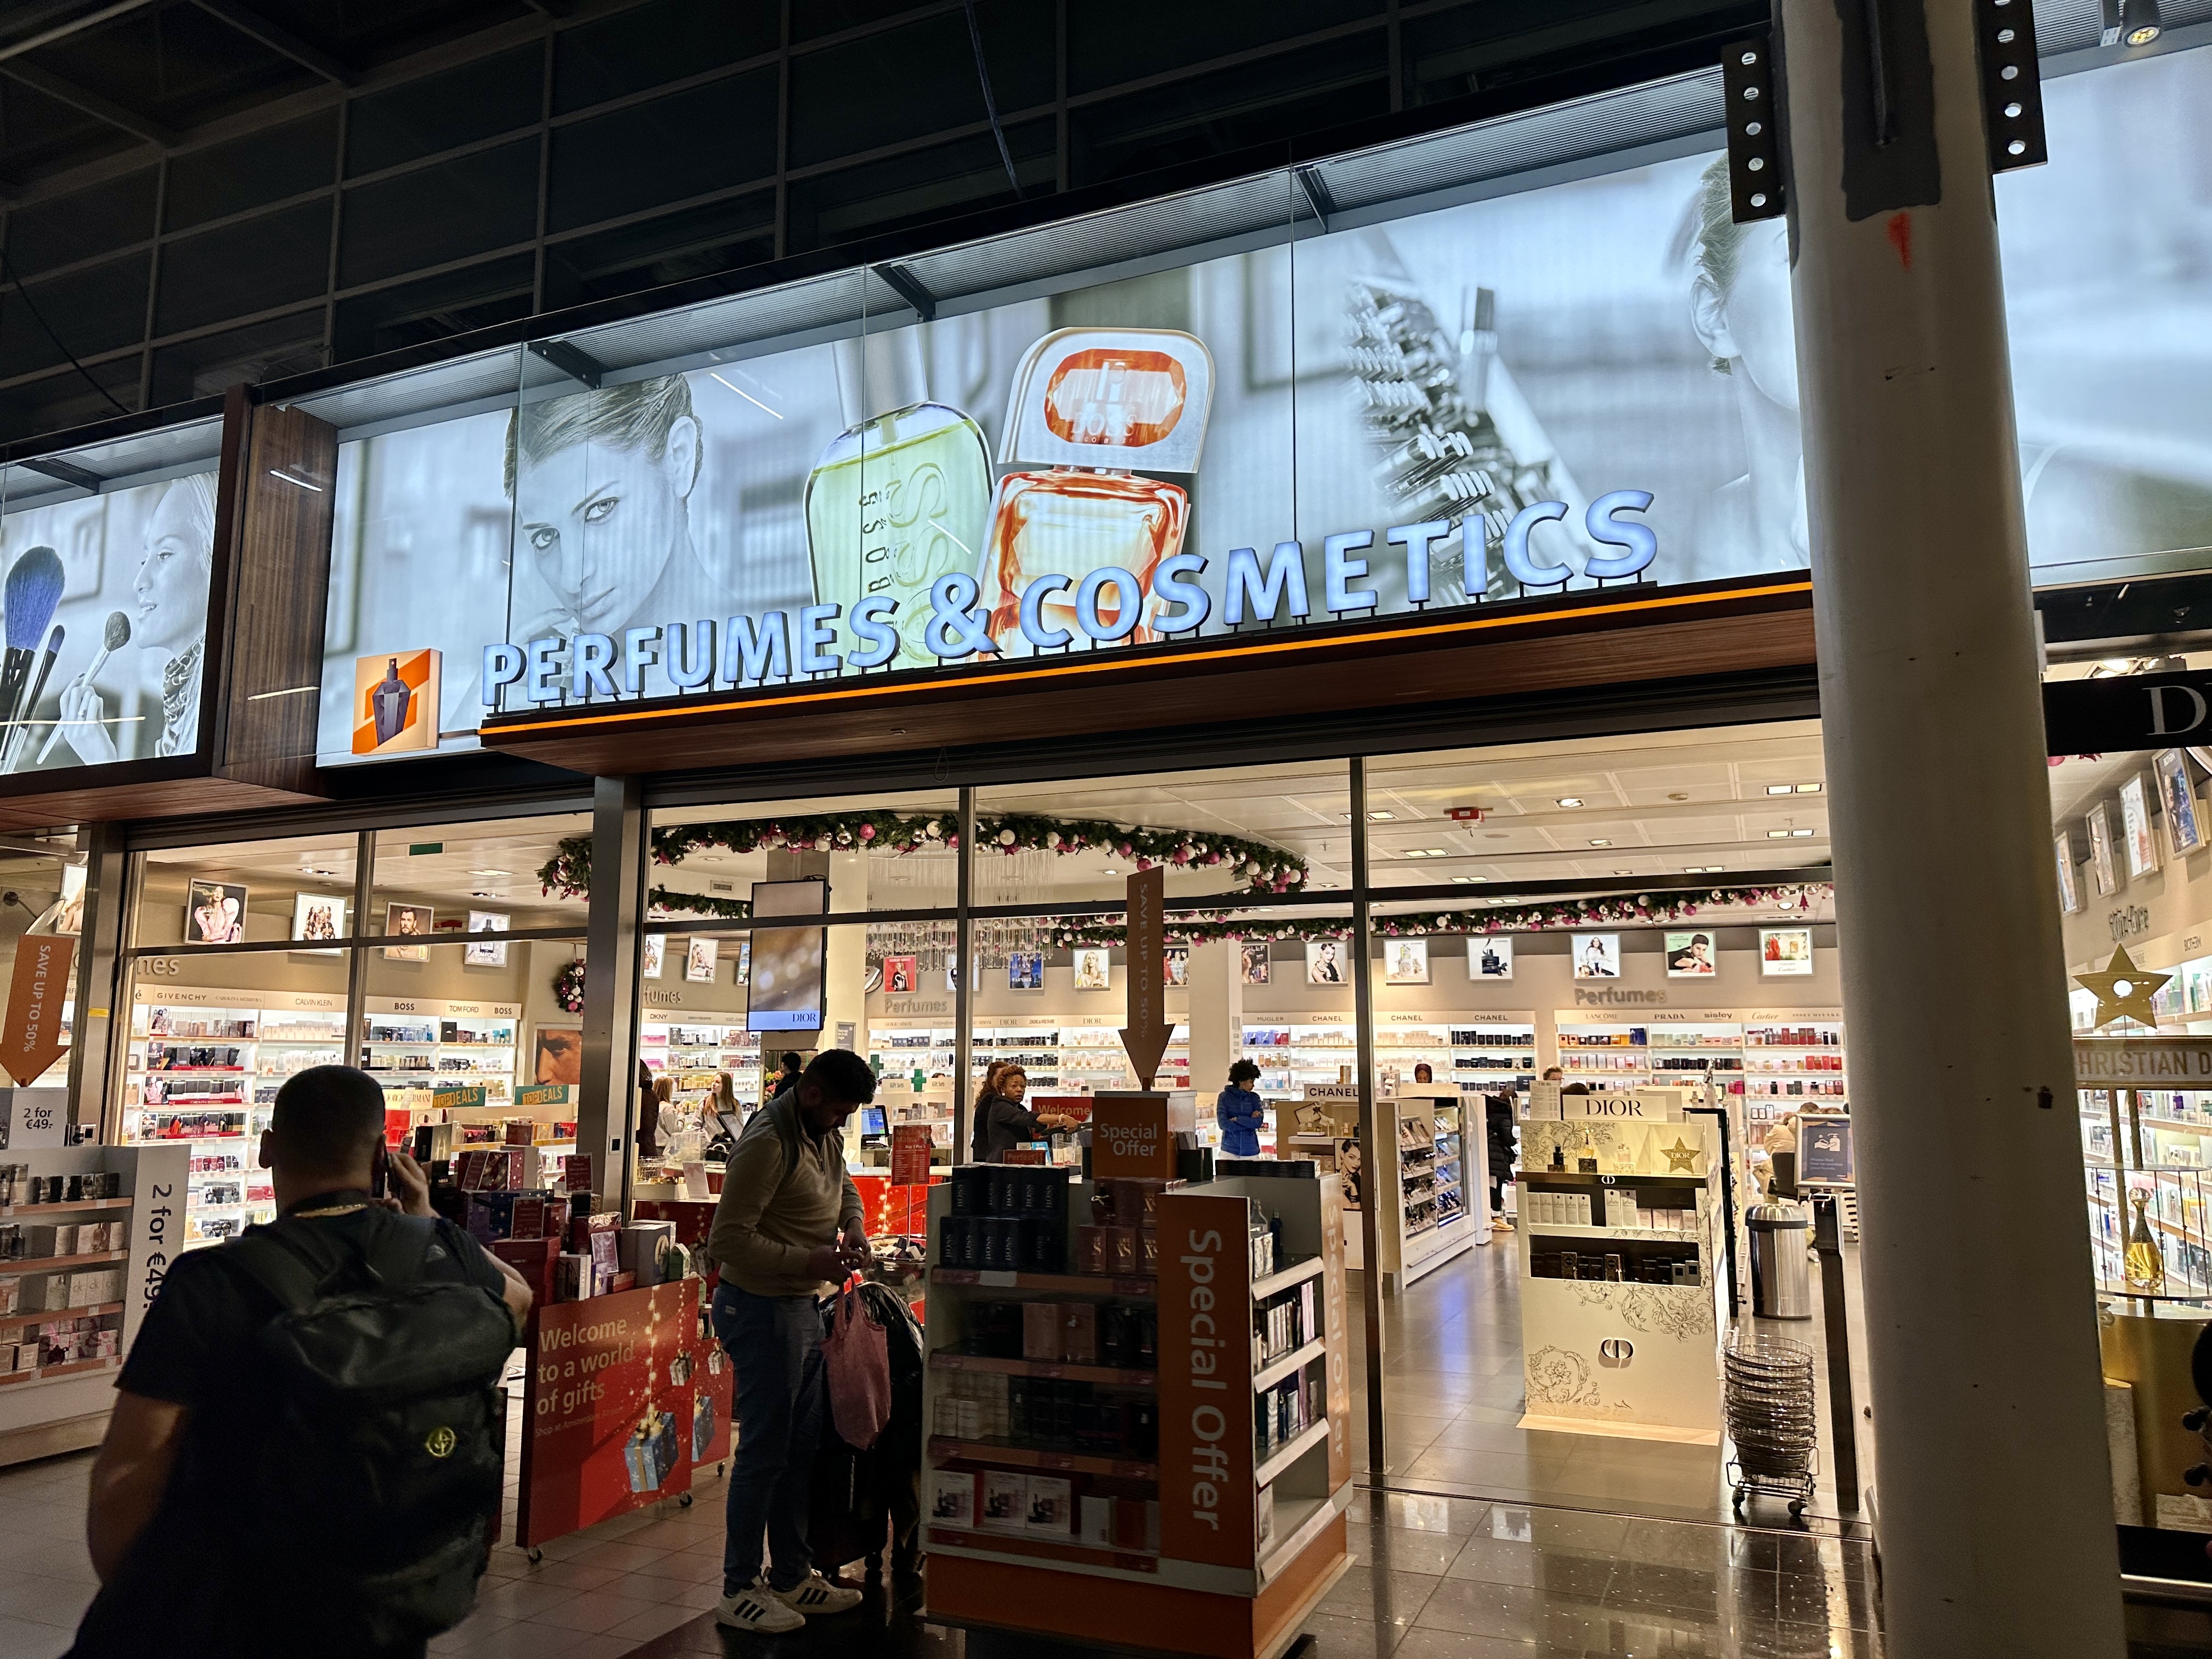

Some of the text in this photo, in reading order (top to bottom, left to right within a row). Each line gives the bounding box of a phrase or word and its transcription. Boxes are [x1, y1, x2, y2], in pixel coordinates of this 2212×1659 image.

[483, 489, 1658, 707] PERFUMES & COSMETICS
[1140, 936, 1148, 960] UP
[1141, 966, 1148, 991] TO
[24, 945, 51, 1053] SAVE UP TO 50%
[157, 992, 207, 1001] GIVENCHY
[644, 986, 682, 1005] fumes
[884, 998, 947, 1014] Perfumes
[1574, 987, 1667, 1006] Perfumes
[792, 1013, 816, 1022] DIOR
[1140, 998, 1148, 1037] 50%
[1752, 1011, 1780, 1020] Cartier
[2078, 1050, 2188, 1076] HRISTIAN
[1309, 1087, 1359, 1097] CHANEL
[24, 1107, 53, 1118] 2 for
[1038, 1104, 1093, 1115] Welcome
[1585, 1099, 1644, 1117] DIOR
[1099, 1123, 1157, 1142] Special
[1113, 1140, 1156, 1156] Offer
[152, 1183, 172, 1199] 2
[1006, 1183, 1014, 1206] BOSS
[1026, 1184, 1035, 1207] BOSS
[149, 1205, 172, 1245] for
[539, 1318, 628, 1353] Welcome
[1327, 1204, 1344, 1458] Special Offer
[537, 1339, 635, 1384] to a world
[1180, 1229, 1229, 1531] Special Offer
[536, 1380, 605, 1415] of gifts
